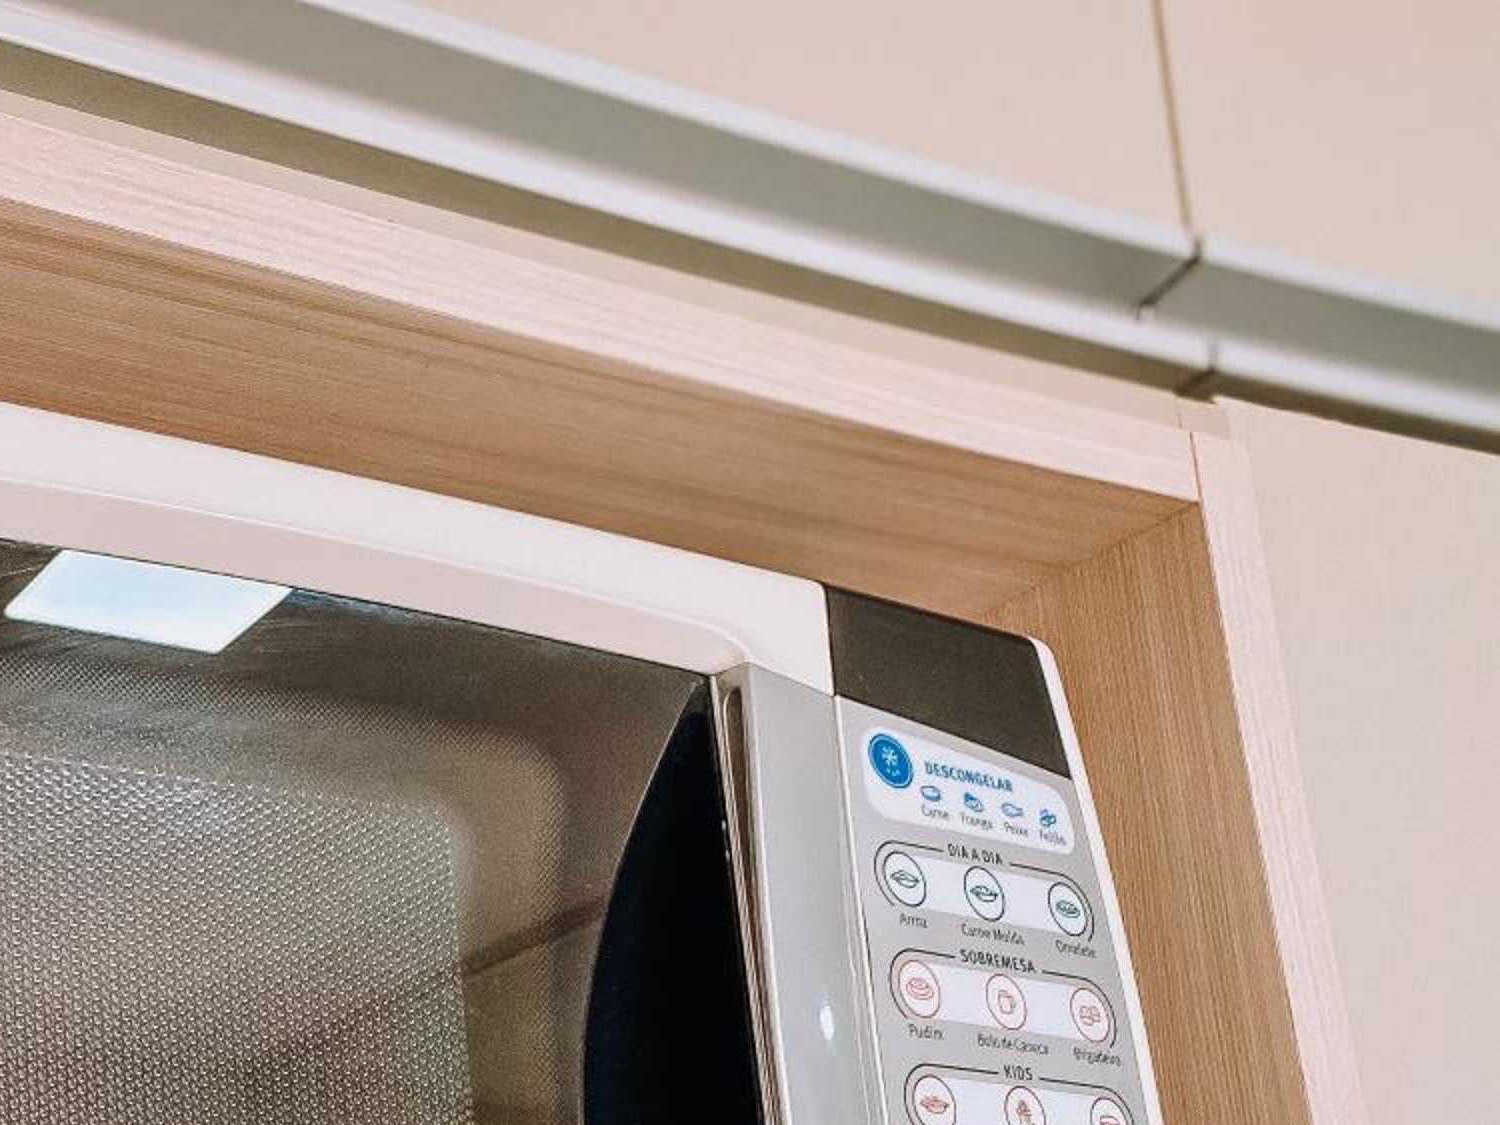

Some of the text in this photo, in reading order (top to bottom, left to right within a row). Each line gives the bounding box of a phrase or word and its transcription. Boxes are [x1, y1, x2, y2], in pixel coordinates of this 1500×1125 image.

[924, 760, 1013, 792] DESCONGELAR
[948, 843, 1003, 865] DIA A DIA
[960, 949, 1037, 973] SOBREMESA
[1003, 1064, 1033, 1081] KIDS
